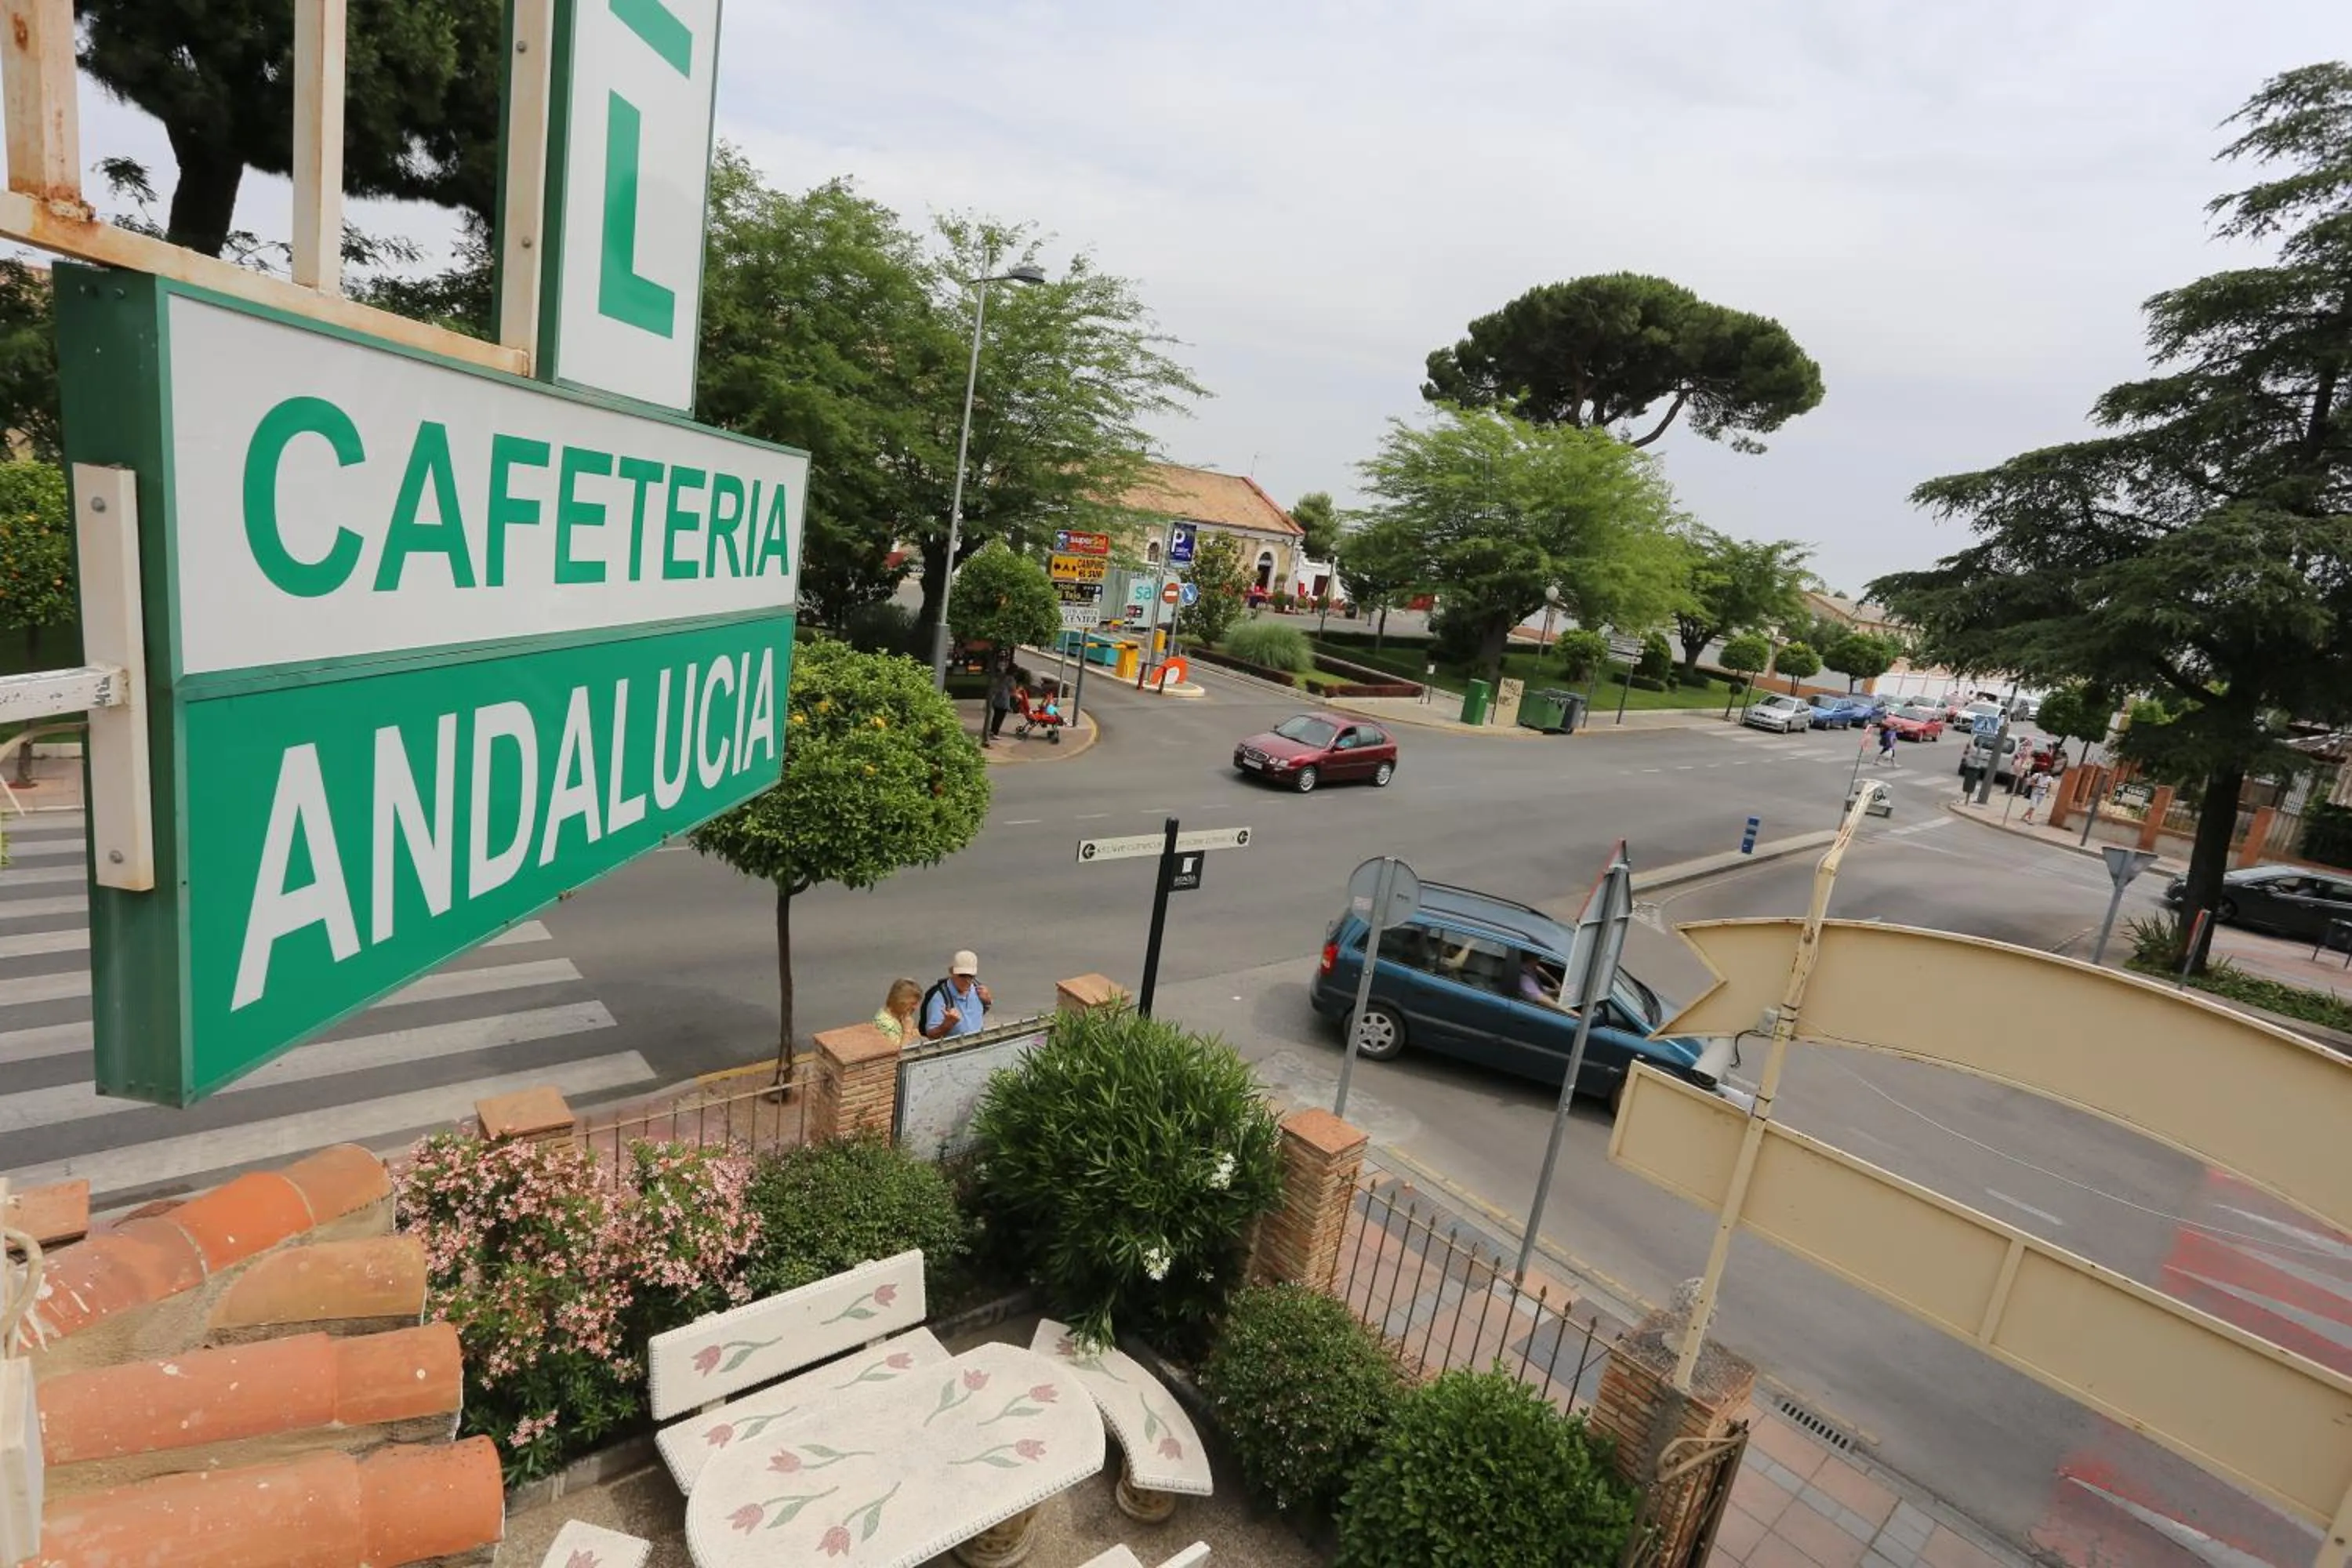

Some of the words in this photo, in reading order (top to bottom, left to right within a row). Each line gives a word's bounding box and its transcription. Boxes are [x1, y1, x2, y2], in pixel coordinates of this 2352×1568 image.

[242, 395, 789, 597] CAFETERIA
[1171, 529, 1185, 553] P
[1078, 559, 1105, 570] CAMPING
[230, 647, 775, 1012] ANDALUCIA
